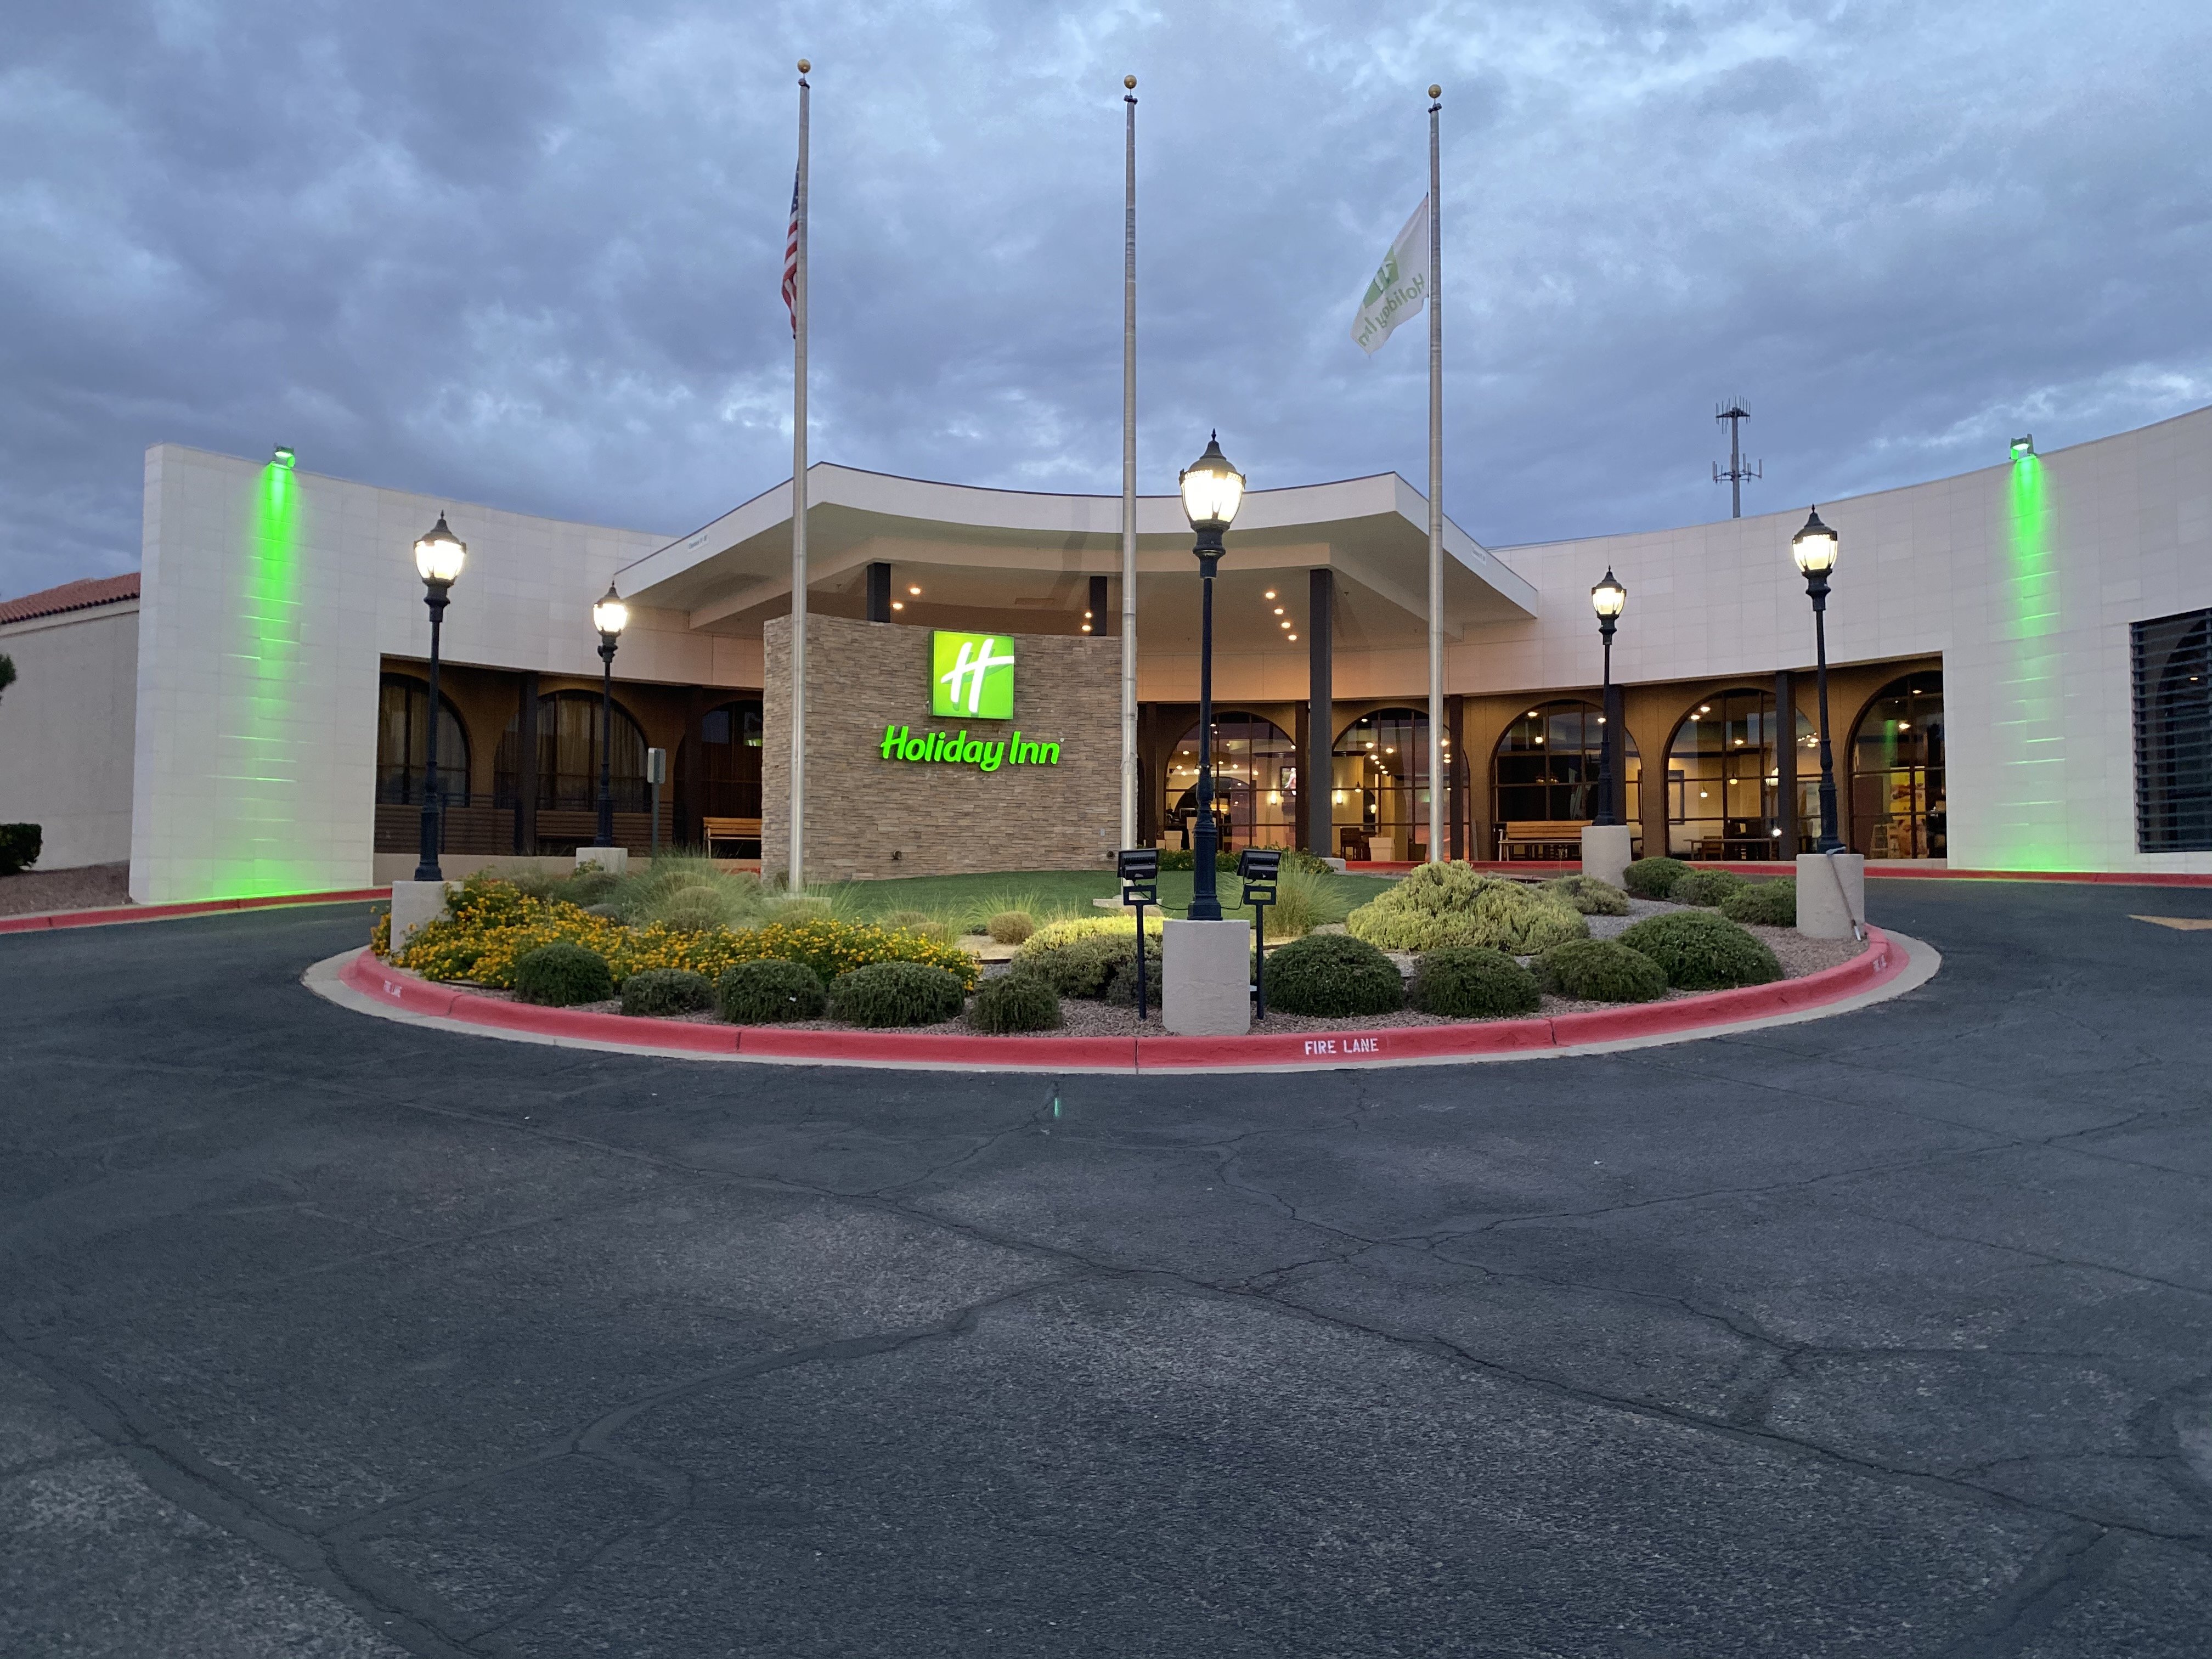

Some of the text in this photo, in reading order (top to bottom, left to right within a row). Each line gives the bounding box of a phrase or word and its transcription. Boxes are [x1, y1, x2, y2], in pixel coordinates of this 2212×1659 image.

[881, 725, 1060, 772] Holiday Inn
[1305, 1038, 1379, 1055] FIRE LANE
